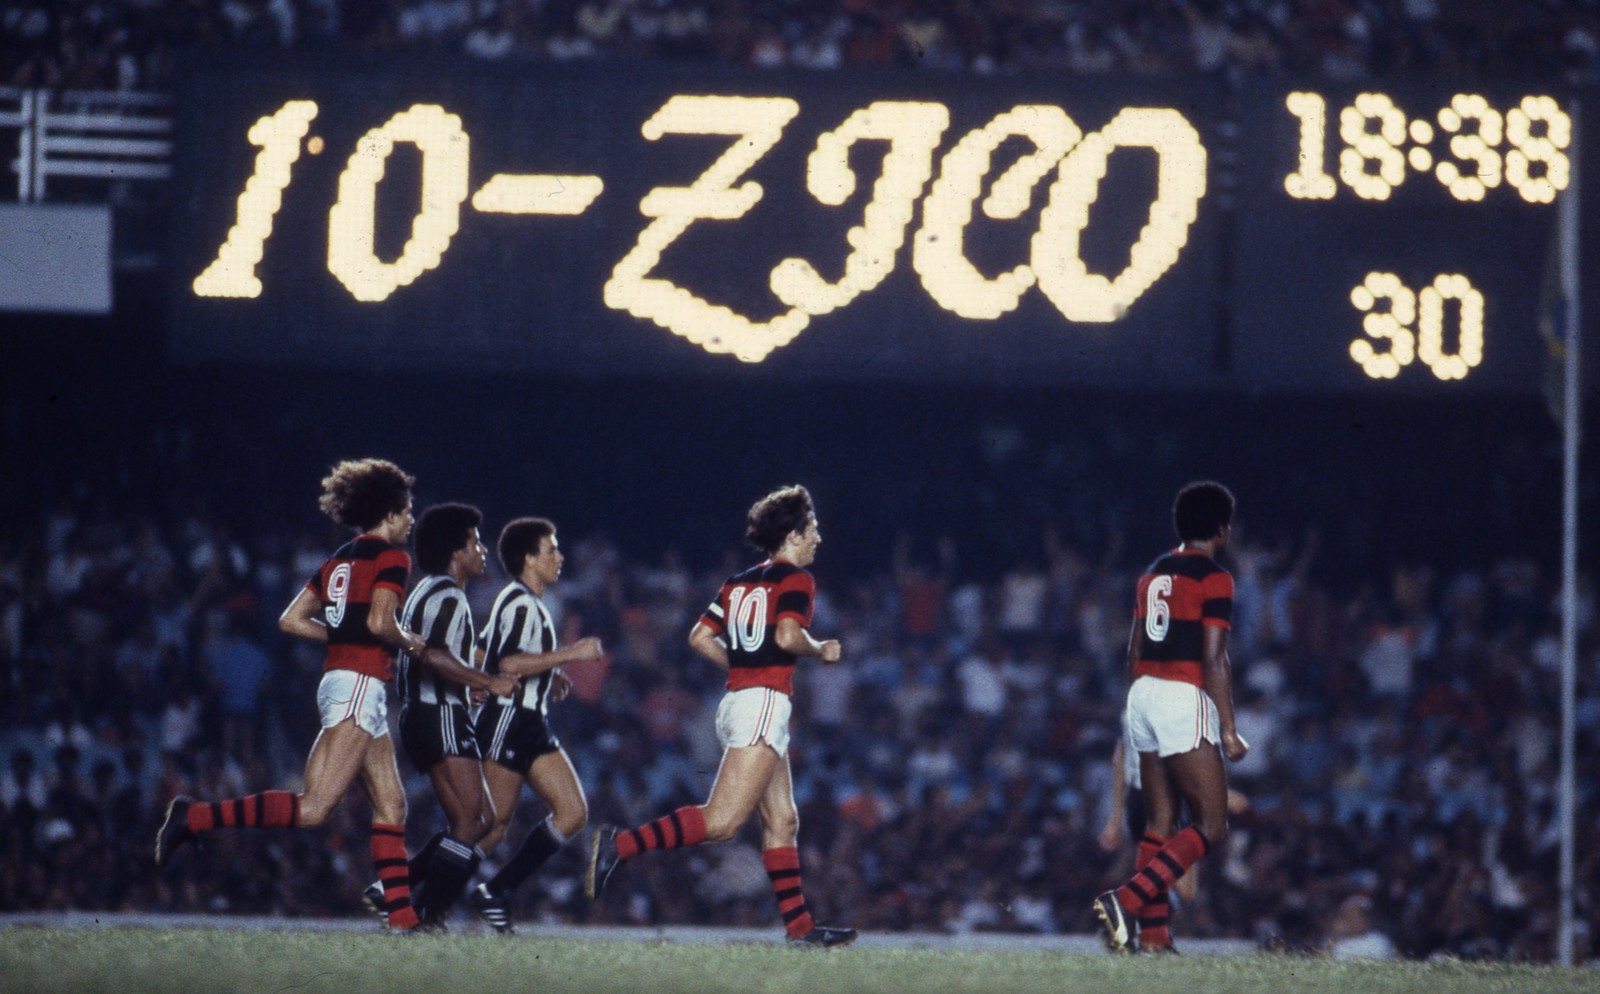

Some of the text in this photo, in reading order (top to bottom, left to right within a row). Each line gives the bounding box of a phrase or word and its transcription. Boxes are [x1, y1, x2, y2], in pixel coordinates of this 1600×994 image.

[1284, 91, 1572, 204] 18:38
[1349, 271, 1484, 381] 30
[325, 562, 352, 628] 9
[727, 586, 768, 653] 10
[1145, 574, 1173, 642] 6
